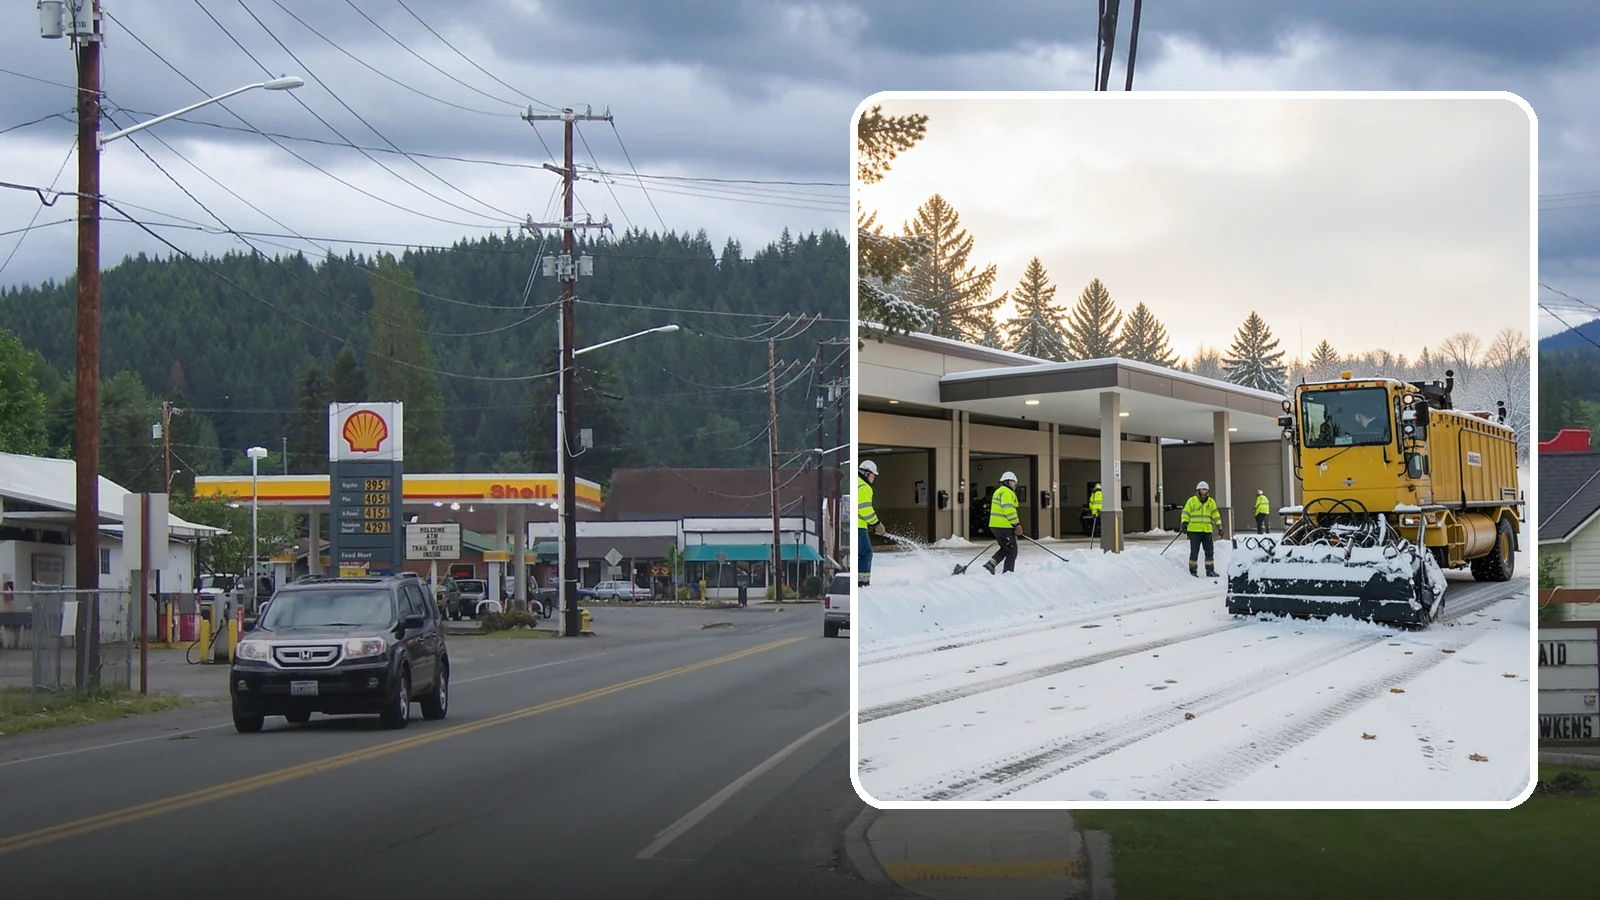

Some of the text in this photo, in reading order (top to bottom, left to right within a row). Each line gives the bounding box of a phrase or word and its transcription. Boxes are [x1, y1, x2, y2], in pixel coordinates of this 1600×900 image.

[366, 480, 383, 490] 395
[490, 484, 548, 498] Shell
[366, 494, 383, 504] 405
[366, 508, 383, 518] 415
[366, 522, 383, 532] 429
